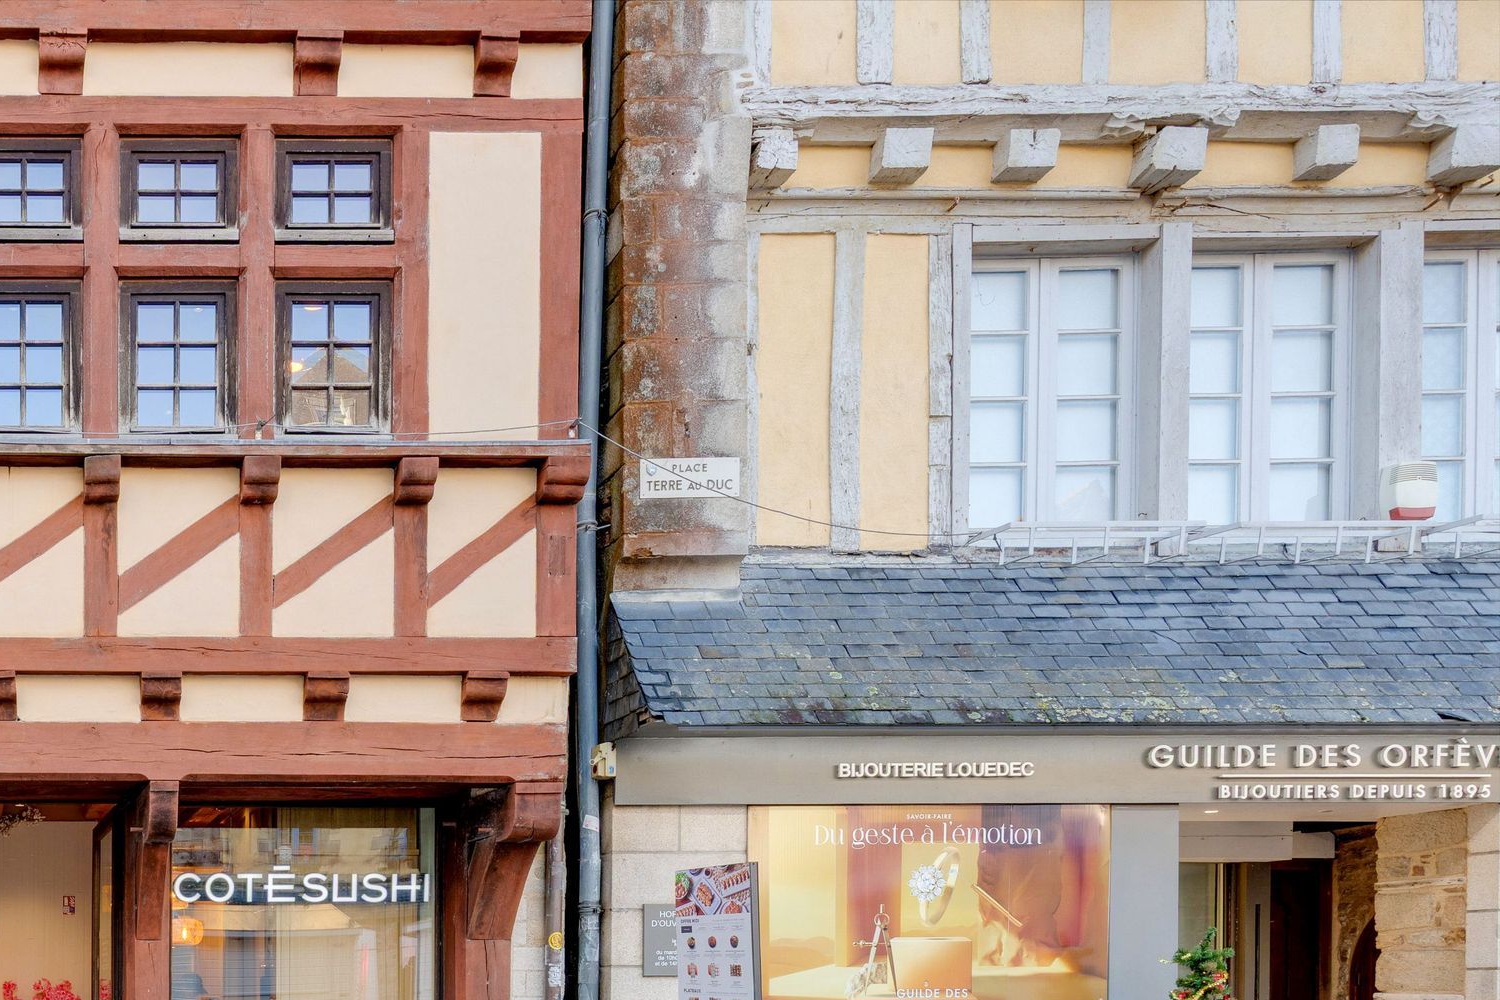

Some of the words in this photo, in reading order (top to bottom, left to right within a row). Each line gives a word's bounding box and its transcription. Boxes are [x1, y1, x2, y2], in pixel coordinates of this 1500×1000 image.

[671, 463, 708, 473] PLACE
[646, 480, 682, 491] TERRE
[687, 482, 701, 491] AU
[707, 479, 733, 490] DUC
[1149, 744, 1276, 768] GUILDE
[1297, 744, 1362, 768] DES
[837, 762, 943, 777] BIJOUTERIE
[947, 762, 1035, 777] LOUEDEC
[1219, 784, 1340, 799] BIJOUTIERS
[1351, 784, 1426, 799] DEPUIS
[1439, 784, 1491, 799] 1895
[815, 824, 844, 845] Du
[852, 823, 914, 849] geste
[921, 824, 934, 845] à
[943, 821, 1042, 845] l'émotion
[896, 988, 941, 999] GUILDE
[945, 988, 968, 999] DES
